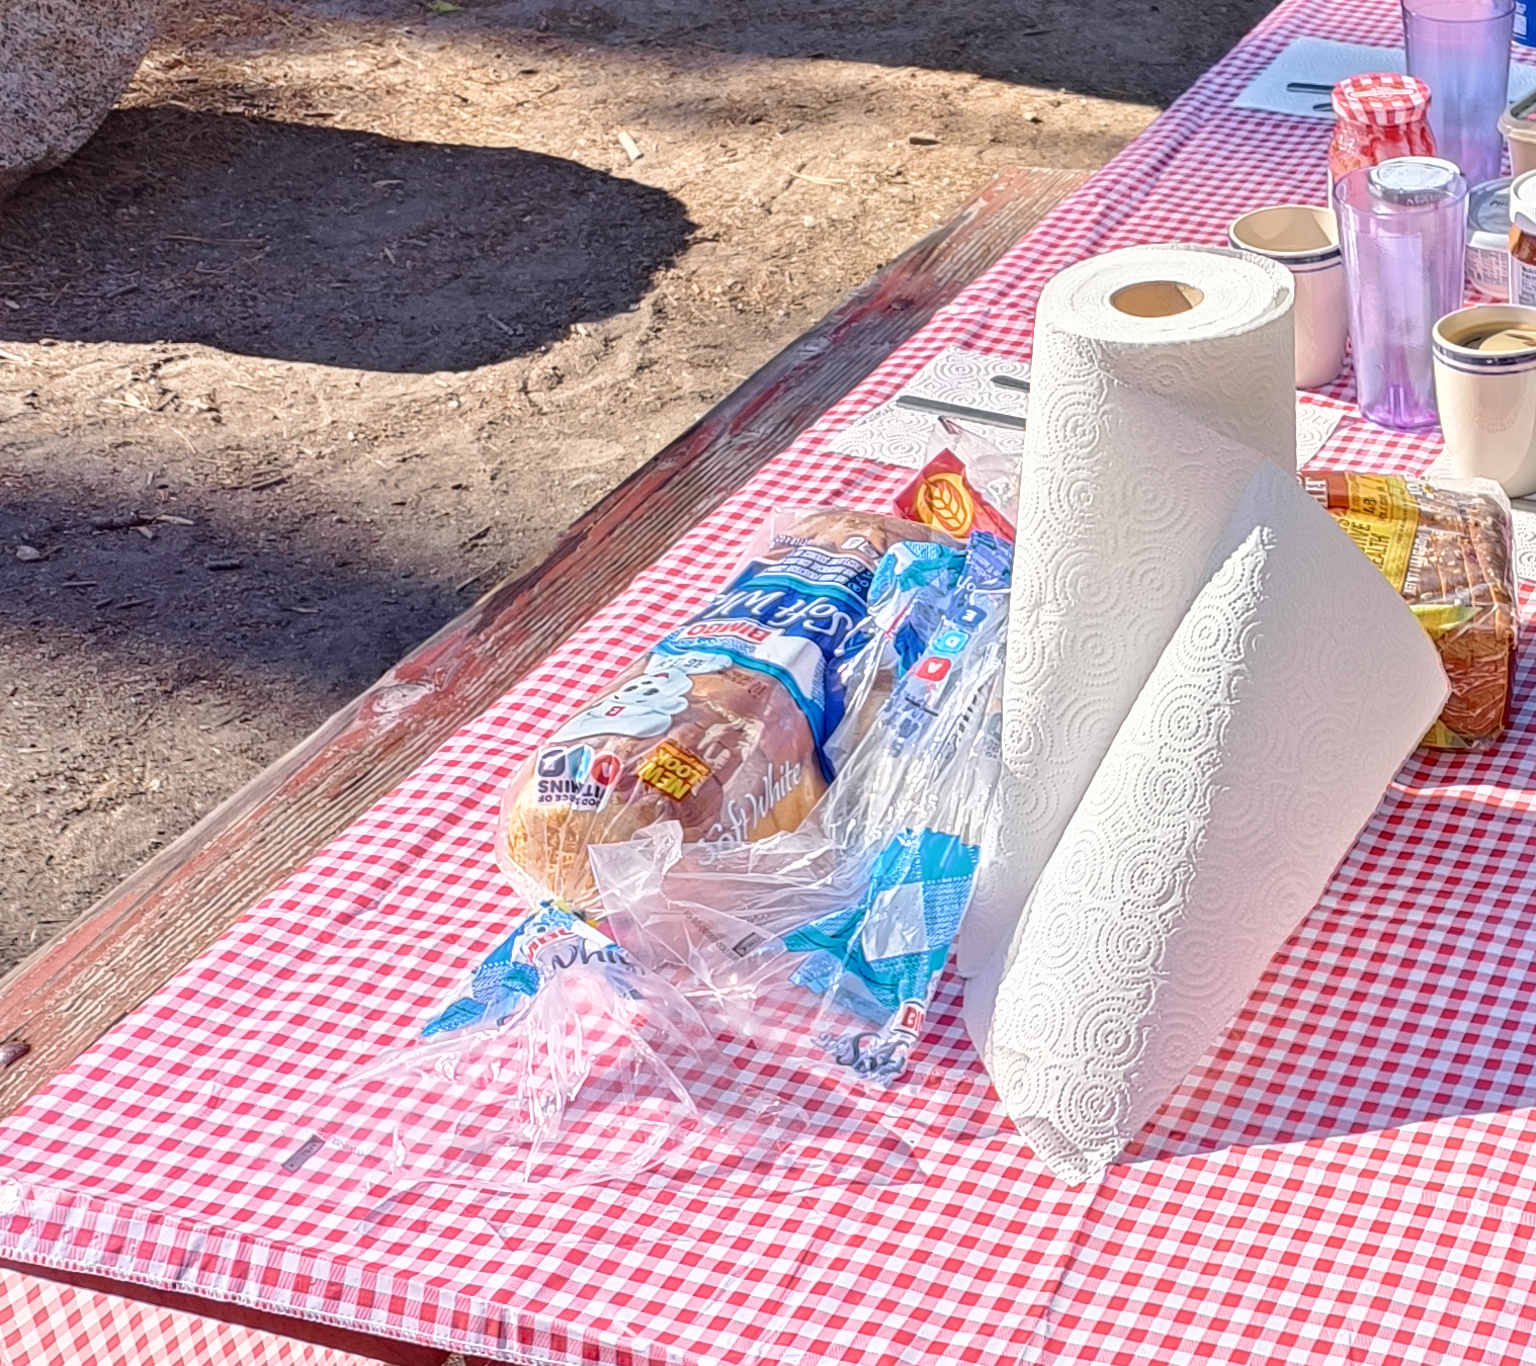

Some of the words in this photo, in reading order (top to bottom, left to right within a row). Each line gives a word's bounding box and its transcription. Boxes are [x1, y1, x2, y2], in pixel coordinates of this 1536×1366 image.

[1364, 532, 1391, 570] EALTH
[686, 621, 773, 643] BIMBO
[767, 596, 854, 636] Soft
[638, 761, 691, 800] NEW
[656, 749, 701, 785] LOOK
[745, 760, 801, 830] White
